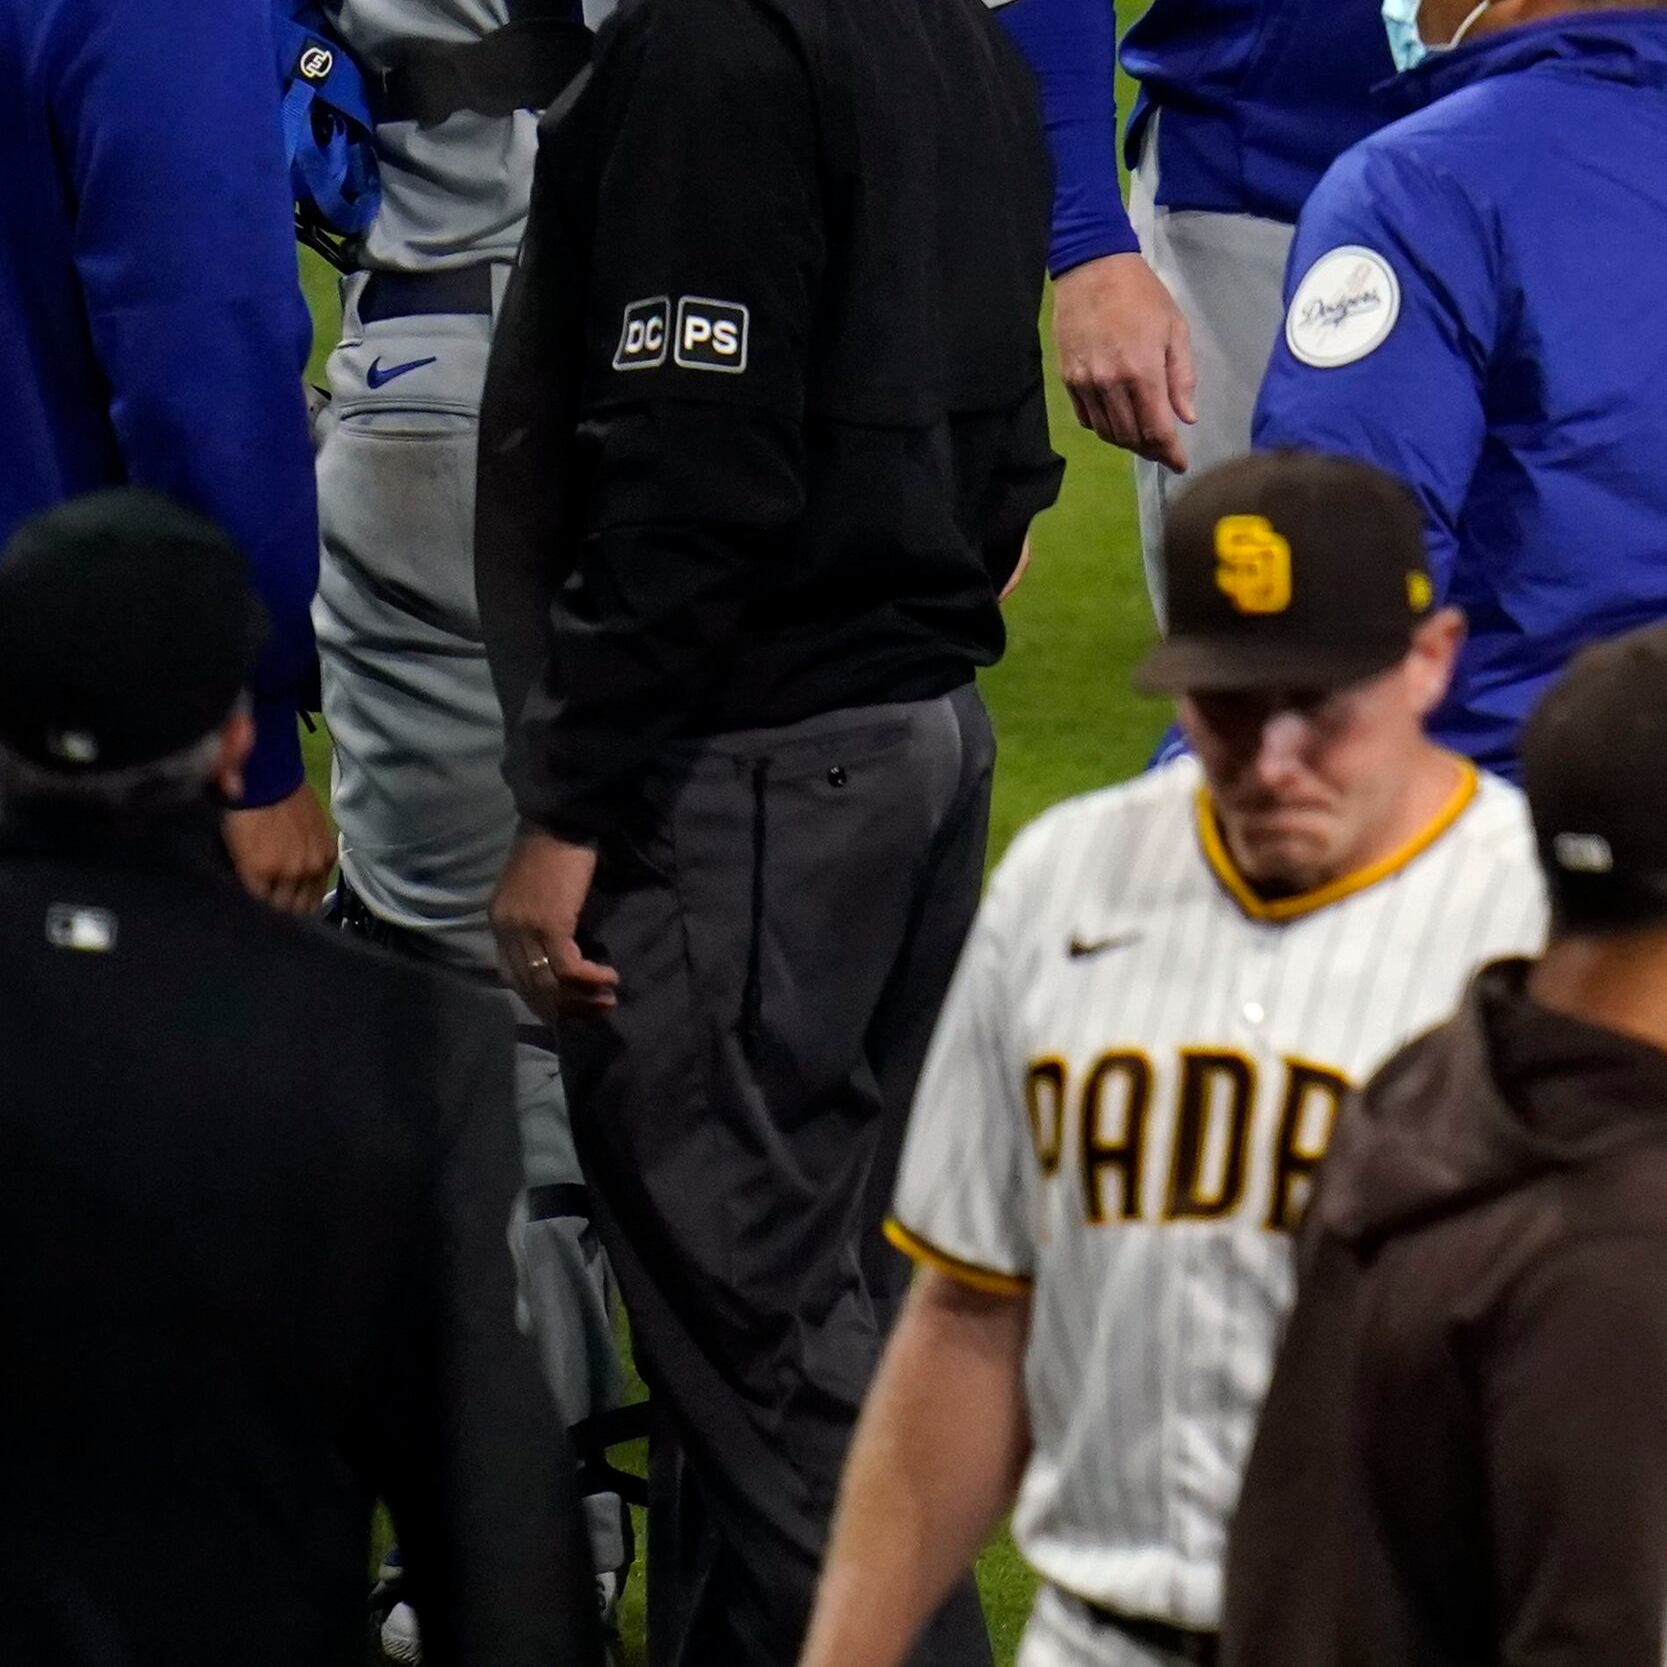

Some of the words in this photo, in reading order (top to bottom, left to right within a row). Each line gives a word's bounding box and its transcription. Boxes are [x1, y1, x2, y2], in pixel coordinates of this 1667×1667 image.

[625, 315, 664, 355] DC
[684, 314, 739, 356] PS
[1214, 513, 1292, 615] SD
